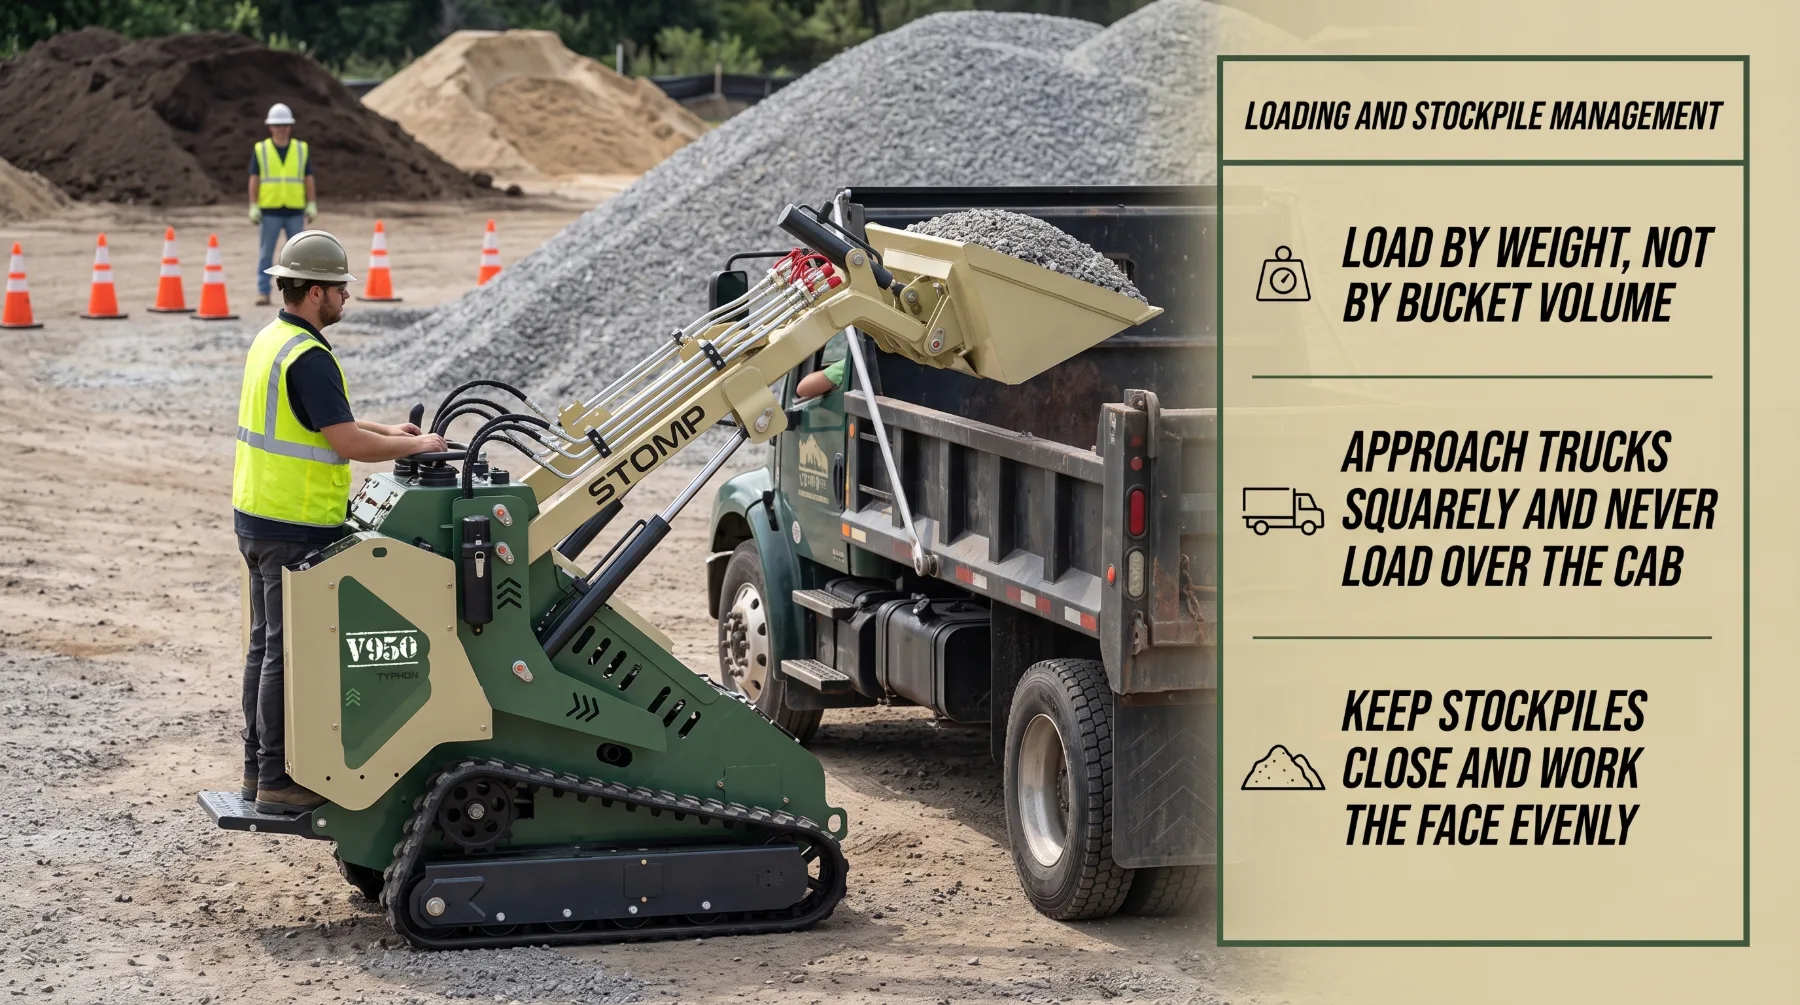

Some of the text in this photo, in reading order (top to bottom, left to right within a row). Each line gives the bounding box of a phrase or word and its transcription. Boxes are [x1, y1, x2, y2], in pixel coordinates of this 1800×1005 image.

[588, 405, 706, 506] STOMP
[346, 636, 418, 662] V950
[377, 671, 419, 681] TYPHON
